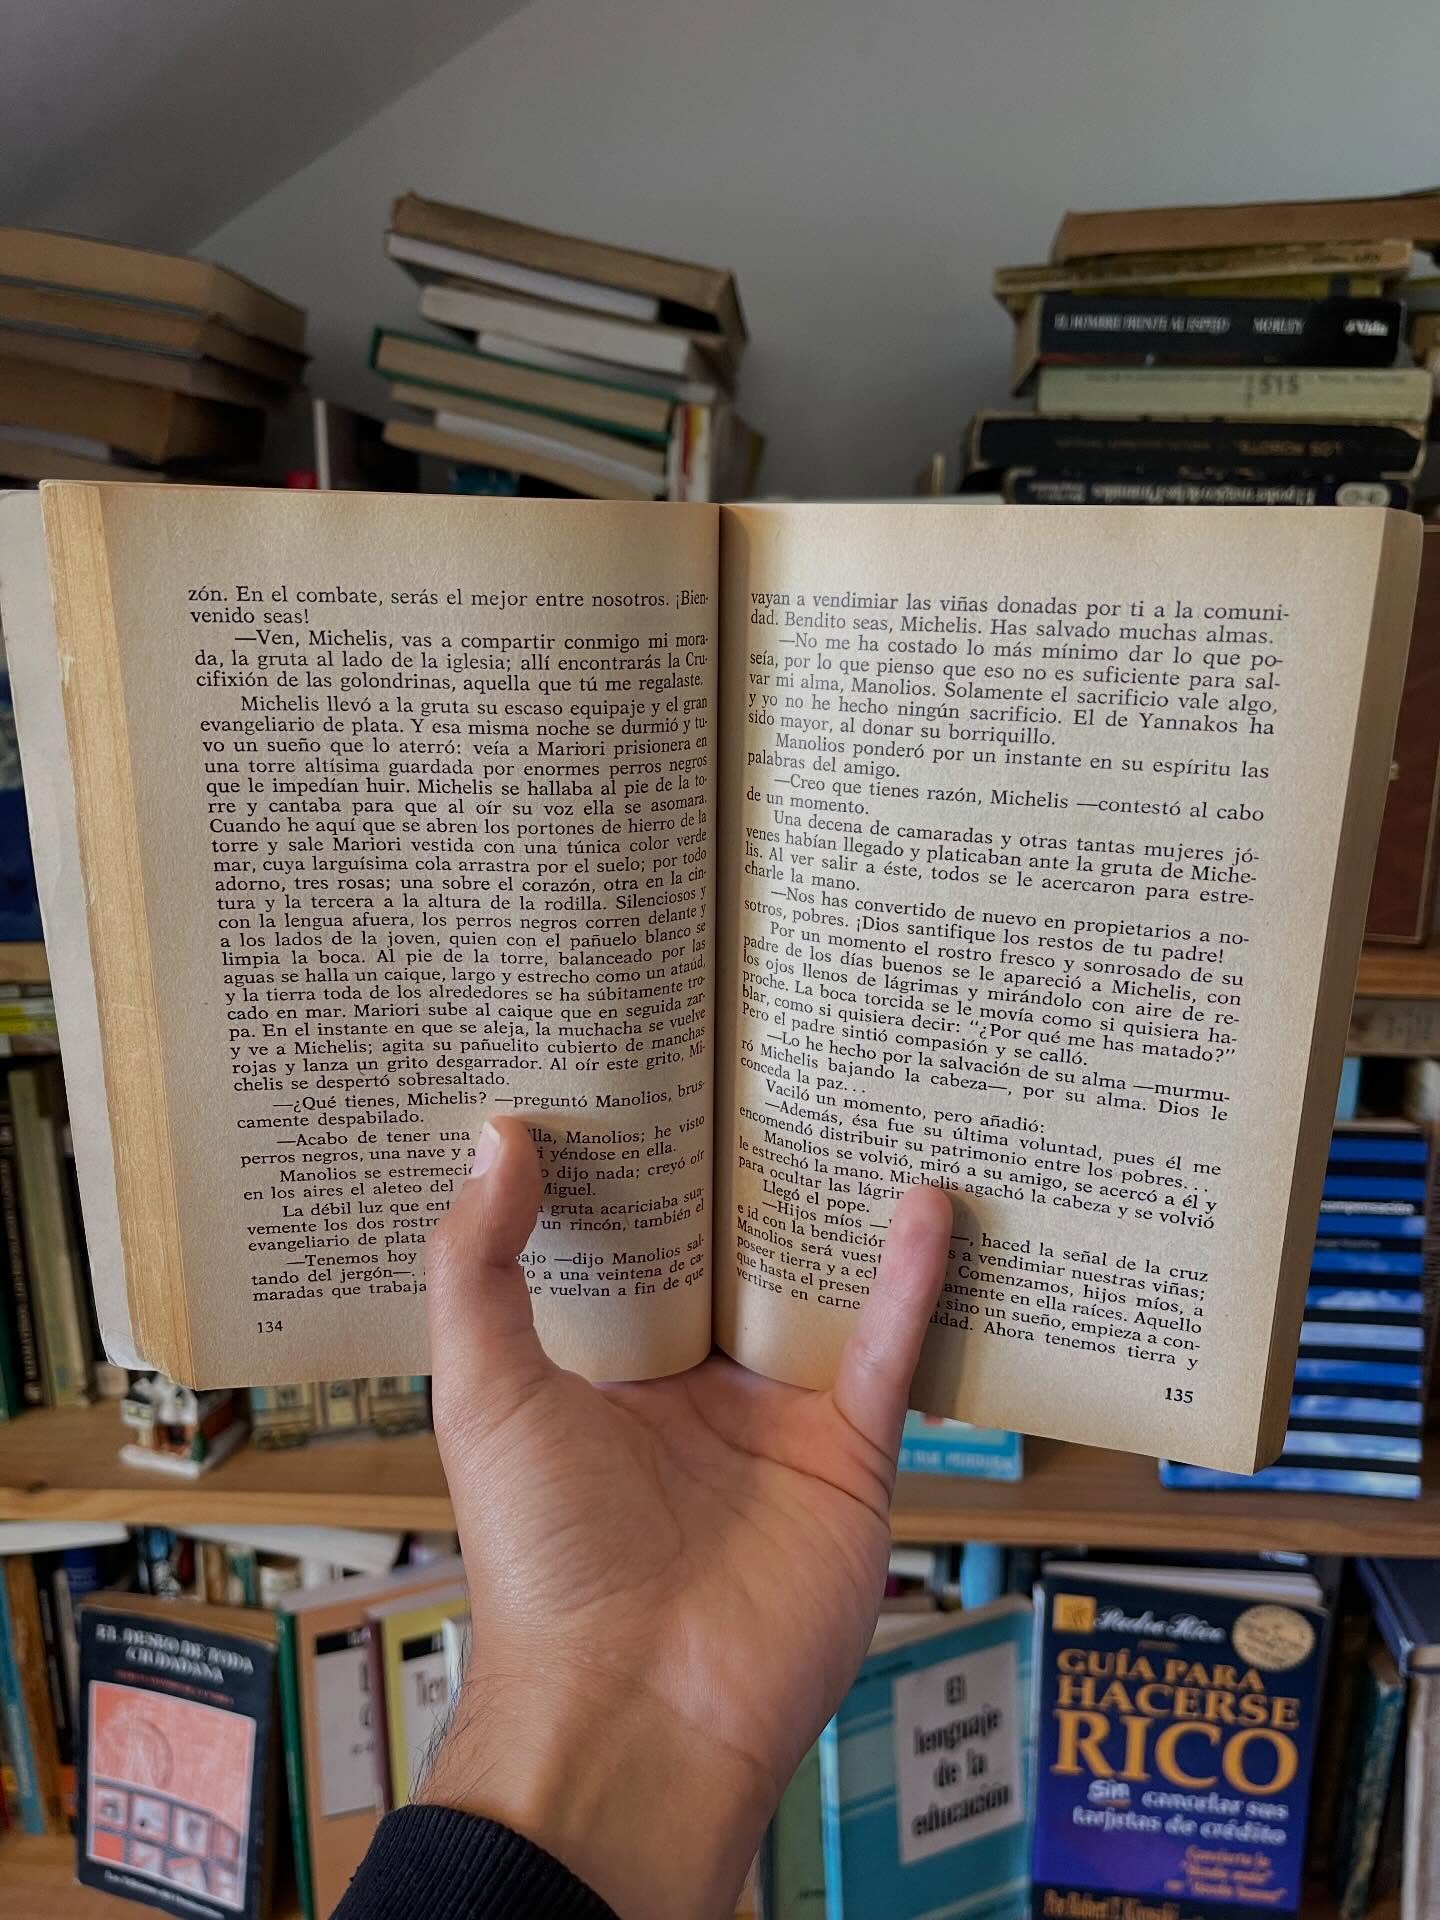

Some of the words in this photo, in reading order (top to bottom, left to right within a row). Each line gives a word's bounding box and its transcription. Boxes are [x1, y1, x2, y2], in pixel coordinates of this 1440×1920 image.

[188, 585, 228, 602] zón.
[235, 585, 264, 602] En
[271, 585, 288, 602] el
[296, 586, 383, 606] combate,
[391, 588, 438, 605] serás
[446, 588, 463, 605] el
[471, 590, 528, 610] mejor
[536, 592, 584, 607] entre
[592, 593, 669, 607] nosotros.
[751, 593, 790, 608] vayan
[797, 596, 805, 606] a
[813, 591, 899, 610] vendimiar
[906, 593, 931, 610] las
[940, 595, 988, 612] viñas
[997, 595, 1077, 615] donadas
[1085, 604, 1122, 620] por
[1131, 600, 1144, 617] ti
[1154, 606, 1165, 618] a
[1174, 600, 1193, 619] la
[1204, 604, 1289, 621] comuni-
[190, 606, 255, 624] venido
[263, 608, 309, 624] seas!
[750, 608, 778, 626] dad.
[785, 611, 846, 628] Bendito
[852, 618, 893, 634] seas,
[900, 616, 982, 634] Michelis.
[990, 618, 1027, 636] Has
[1036, 619, 1110, 639] salvado
[1119, 622, 1196, 642] muchas
[1206, 624, 1273, 644] almas.
[241, 694, 320, 712] Michelis
[326, 695, 372, 712] llevó
[379, 701, 390, 712] a
[396, 696, 414, 713] la
[421, 700, 470, 717] gruta
[477, 703, 498, 715] su
[504, 704, 563, 716] escaso
[570, 699, 646, 720] equipaje
[650, 702, 661, 718] y
[666, 696, 678, 712] el
[683, 698, 708, 715] gran
[748, 749, 805, 769] palabras
[813, 756, 836, 772] del
[843, 760, 900, 780] amigo.
[211, 840, 259, 853] torre
[267, 841, 278, 856] y
[288, 836, 324, 852] sale
[332, 836, 402, 852] Mariori
[410, 837, 474, 853] vestida
[484, 843, 515, 854] con
[524, 844, 558, 855] una
[566, 839, 620, 854] túnica
[629, 835, 670, 852] color
[676, 828, 706, 847] verde
[744, 860, 784, 880] charle
[791, 868, 803, 884] la
[811, 876, 860, 891] mano.
[744, 900, 786, 920] sotros,
[792, 908, 848, 927] pobres.
[907, 923, 996, 944] santifique
[1003, 928, 1029, 946] los
[1038, 936, 1093, 952] restos
[1102, 938, 1124, 954] de
[1134, 943, 1152, 957] tu
[1161, 945, 1224, 964] padre!
[821, 890, 848, 908] has
[854, 900, 946, 919] convertido
[954, 905, 975, 921] de
[982, 912, 1036, 927] nuevo
[1044, 918, 1066, 930] en
[1074, 920, 1191, 940] propietarios
[1199, 931, 1210, 942] a
[1218, 933, 1249, 945] no-
[233, 1076, 284, 1092] chelis
[291, 1080, 309, 1090] se
[316, 1071, 390, 1092] despertó
[398, 1071, 510, 1086] sobresaltado.
[344, 1094, 400, 1114] tienes,
[407, 1090, 487, 1106] Michelis?
[596, 1090, 672, 1108] Manolios,
[677, 1080, 705, 1098] brus-
[237, 1116, 310, 1129] camente
[318, 1109, 424, 1128] despabilado.
[766, 1078, 810, 1102] Vaciló
[816, 1094, 836, 1106] un
[843, 1098, 926, 1120] momento,
[934, 1110, 972, 1124] pero
[978, 1114, 1044, 1134] añadió:
[763, 1178, 800, 1202] Llegó
[806, 1191, 819, 1206] el
[826, 1198, 870, 1214] pope.
[257, 1321, 284, 1333] 134
[1164, 1387, 1194, 1404] 135
[1057, 1648, 1156, 1681] GUÍA
[1164, 1658, 1265, 1693] PARA
[945, 1674, 966, 1705] El
[1056, 1673, 1300, 1730] HACERSE
[913, 1705, 1001, 1756] lenguaje
[934, 1758, 957, 1788] de
[966, 1749, 987, 1778] la
[1051, 1708, 1299, 1796] RICO
[1088, 1780, 1131, 1802] Sin
[1141, 1790, 1244, 1815] cancelar
[1245, 1800, 1289, 1820] sus
[1073, 1805, 1162, 1833] tarjetas
[1164, 1814, 1197, 1836] de
[1199, 1819, 1287, 1846] crédito
